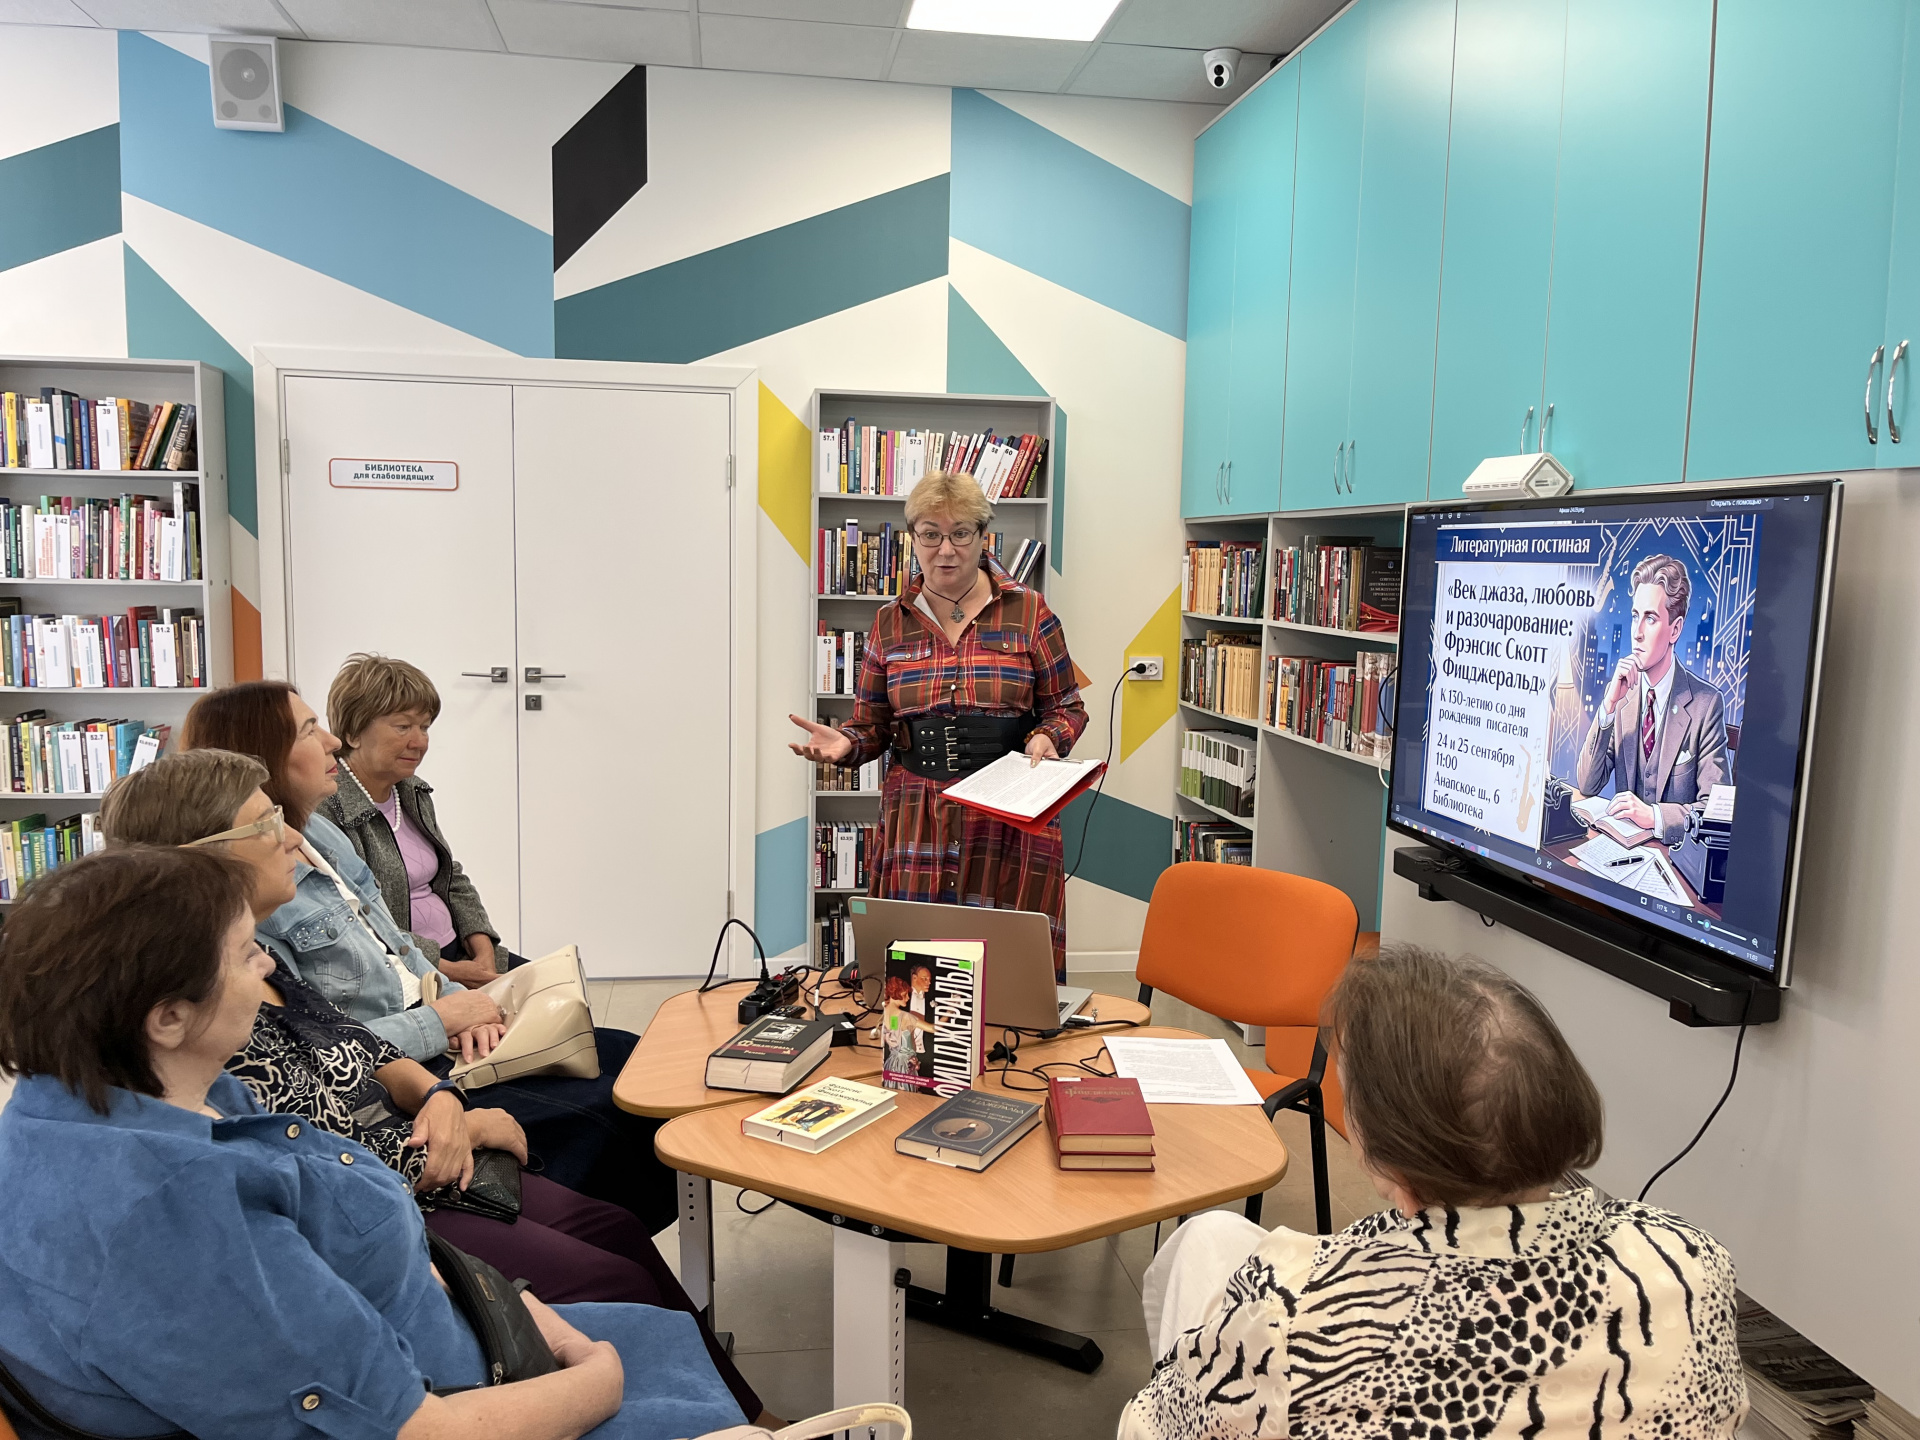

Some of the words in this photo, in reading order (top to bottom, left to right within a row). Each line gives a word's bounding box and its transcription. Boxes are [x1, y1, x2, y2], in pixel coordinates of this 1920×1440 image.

[909, 438, 922, 446] 57.3
[353, 472, 370, 480] для
[371, 472, 435, 481] слабовидящих
[364, 463, 424, 473] БИБЛИОТЕКА
[1450, 535, 1528, 562] Литературная
[1531, 537, 1591, 554] гостиная
[1448, 578, 1476, 600] «Век
[1479, 584, 1528, 606] джаза,
[1531, 582, 1595, 608] любовь
[1445, 609, 1454, 625] и
[1456, 610, 1574, 637] разочарование:
[1444, 630, 1502, 658] Фрэнсис
[1505, 637, 1549, 664] Скотт
[1442, 656, 1546, 695] Фицджеральд»
[1440, 687, 1446, 702] К
[1448, 689, 1493, 712] 130-летию
[1495, 702, 1506, 714] со
[1508, 704, 1525, 718] дня
[1438, 708, 1481, 728] рождения
[1486, 717, 1529, 738] писателя
[1436, 751, 1458, 771] 11:00
[1437, 732, 1448, 748] 24
[1449, 738, 1456, 750] и
[1457, 737, 1469, 754] 25
[1471, 744, 1515, 768] сентября
[1434, 770, 1476, 797] Анапское
[1478, 788, 1491, 804] ш.,
[1493, 788, 1500, 804] 6
[1432, 789, 1484, 820] Библиотека
[933, 957, 974, 1098] ФИЦДЖЕРАЛЬД
